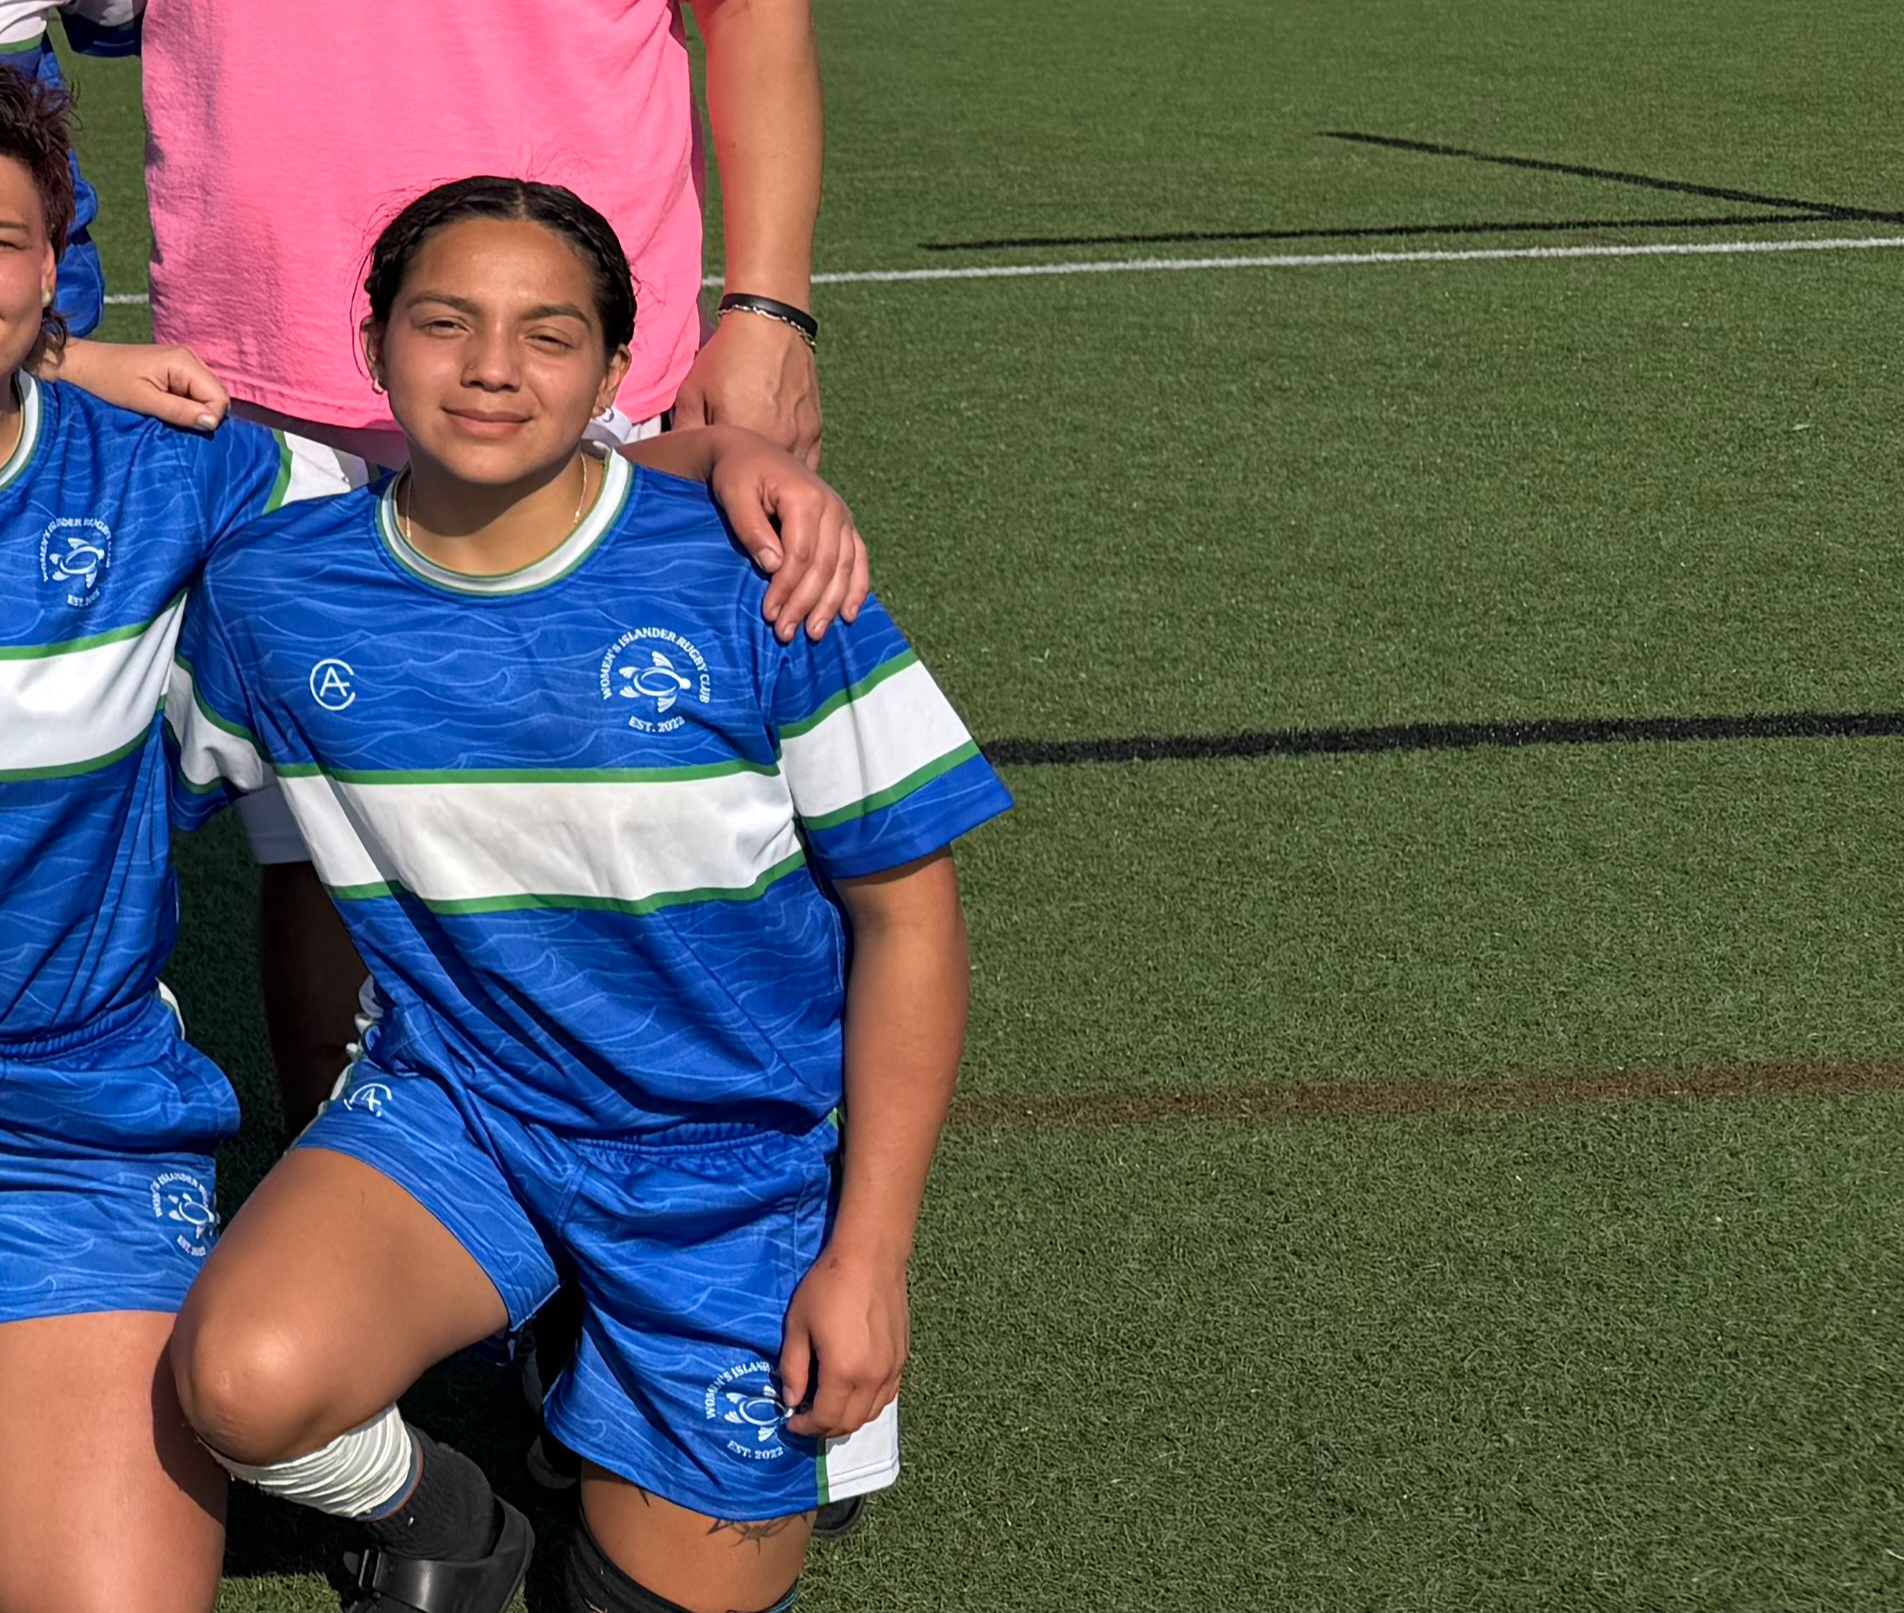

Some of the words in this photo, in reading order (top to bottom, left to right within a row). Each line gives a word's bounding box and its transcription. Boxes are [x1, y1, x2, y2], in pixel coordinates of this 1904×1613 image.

[600, 643, 622, 701] WOMEN'S
[618, 626, 677, 648] ISLANDER
[676, 636, 708, 672] RUGBY
[699, 674, 711, 704] CLUB
[628, 716, 656, 733] EST.
[657, 716, 685, 733] 2022
[727, 1439, 752, 1458] EST.
[754, 1446, 784, 1460] 2022
